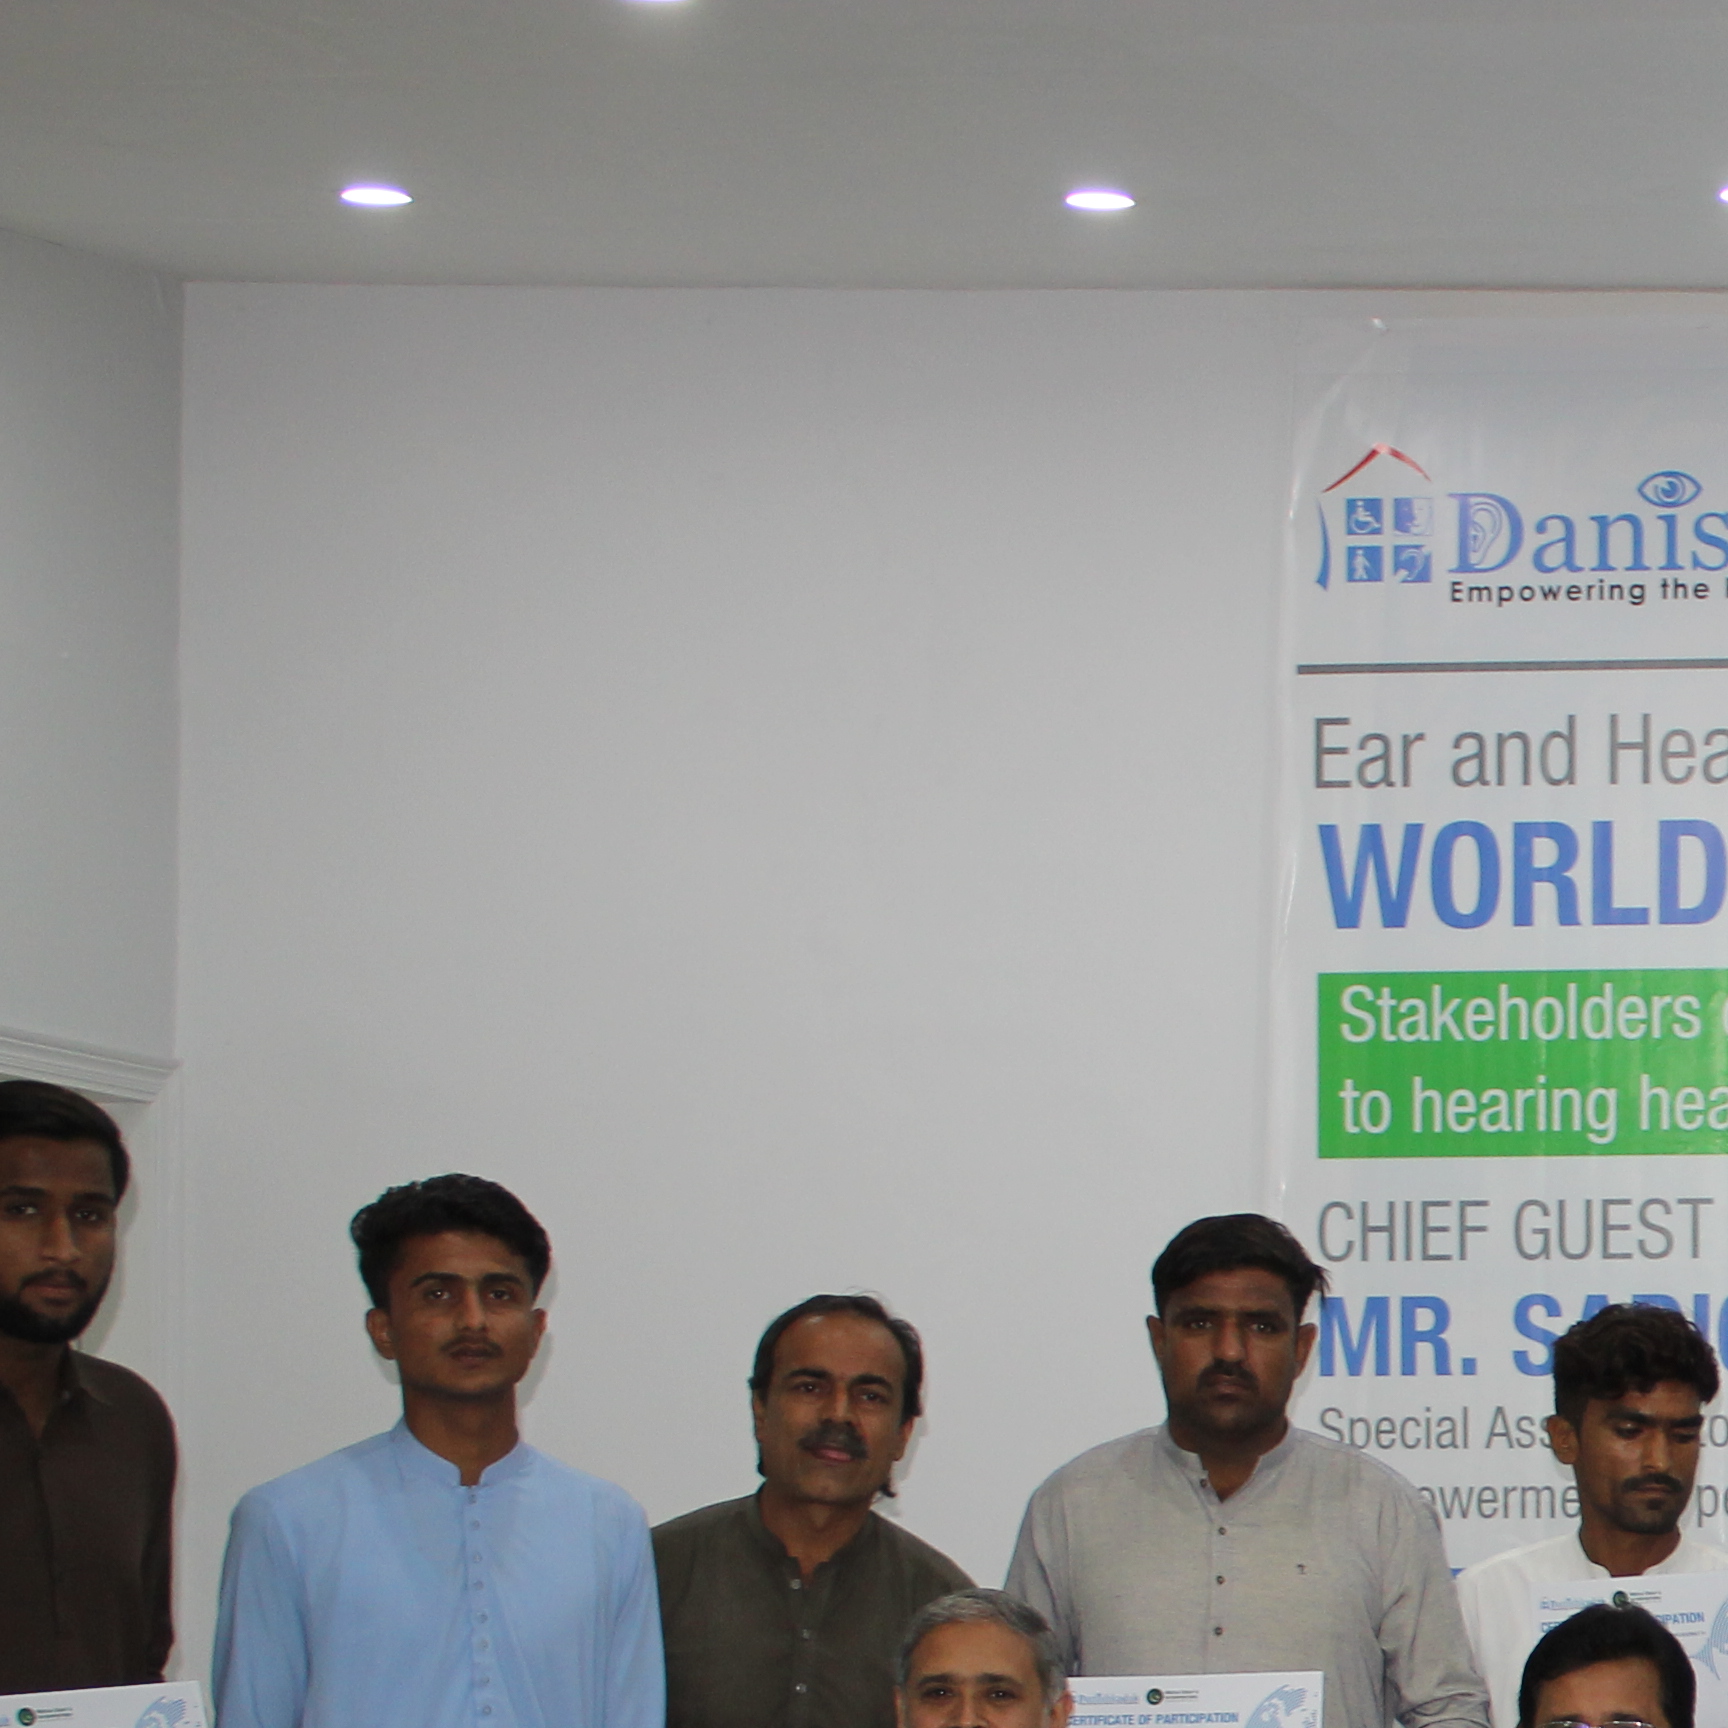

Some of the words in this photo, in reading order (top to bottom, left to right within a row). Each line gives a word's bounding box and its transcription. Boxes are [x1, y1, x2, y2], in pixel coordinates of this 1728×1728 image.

[1451, 577, 1646, 606] Empowering
[1661, 577, 1710, 600] the
[1313, 715, 1427, 789] Ear
[1451, 713, 1577, 787] and
[1317, 819, 1728, 931] WORLD
[1339, 983, 1702, 1043] Stakeholders
[1340, 1080, 1391, 1134] to
[1413, 1075, 1618, 1145] hearing
[1316, 1199, 1490, 1264] CHIEF
[1514, 1197, 1714, 1263] GUEST
[1318, 1295, 1477, 1377] MR.
[1319, 1405, 1470, 1450] Special
